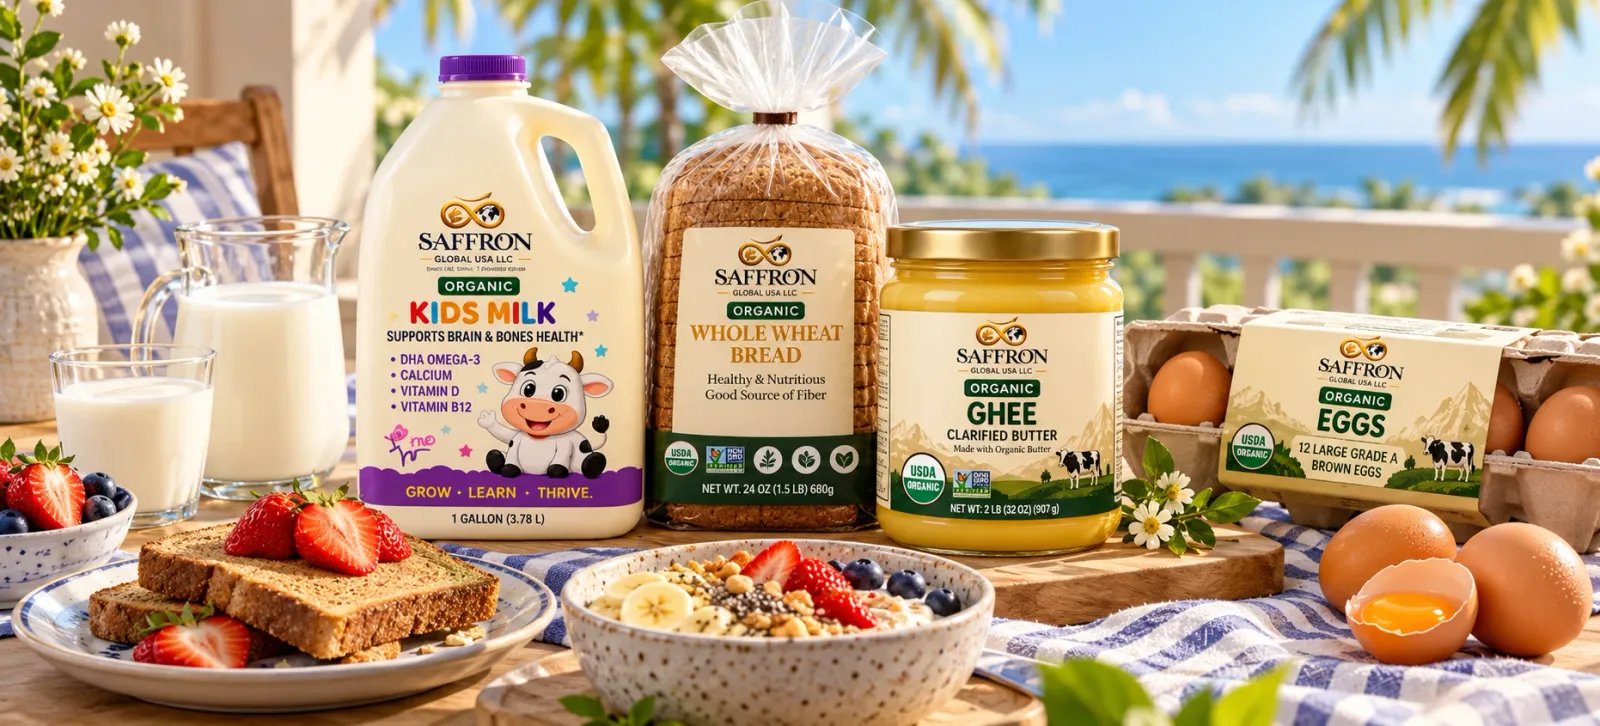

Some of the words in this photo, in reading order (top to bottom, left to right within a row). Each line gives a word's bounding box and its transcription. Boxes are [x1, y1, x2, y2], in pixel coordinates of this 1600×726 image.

[418, 233, 532, 251] SAFFRON
[715, 269, 817, 286] SAFFRON
[445, 281, 513, 292] ORGANIC
[410, 301, 479, 325] KIDS
[488, 301, 556, 325] MILK
[733, 306, 799, 316] ORGANIC
[387, 331, 445, 342] SUPPORTS
[448, 331, 482, 342] BRAIN
[485, 331, 493, 342] &
[496, 331, 533, 342] BONES
[690, 325, 767, 341] WHOLE
[771, 325, 844, 341] WHEAT
[401, 354, 424, 365] DHA
[427, 354, 481, 365] OMEGA-3
[730, 347, 802, 363] BREAD
[957, 349, 1048, 364] SAFFRON
[1319, 358, 1405, 380] SAFFRON
[401, 370, 452, 381] CALCIUM
[708, 374, 752, 387] Healthy
[755, 374, 765, 384] &
[768, 374, 826, 384] Nutritious
[1329, 376, 1356, 385] GLOBAL
[401, 386, 448, 397] VITAMIN
[451, 386, 460, 397] D
[706, 390, 737, 400] Good
[741, 390, 780, 400] Source
[783, 390, 795, 400] of
[798, 390, 827, 400] Fiber
[970, 384, 1034, 394] ORGANIC
[1326, 391, 1386, 407] ORGANIC
[401, 402, 448, 413] VITAMIN
[451, 402, 472, 413] B12
[967, 401, 1037, 426] GHEE
[1317, 408, 1386, 438] EGGS
[947, 429, 1008, 441] CLARIFIED
[1012, 429, 1058, 441] BUTTER
[1242, 434, 1266, 447] USDA
[672, 448, 692, 457] USDA
[954, 445, 974, 453] Made
[976, 445, 994, 453] with
[995, 445, 1026, 455] Organic
[1028, 445, 1051, 453] Butter
[1237, 449, 1268, 459] ORGANIC
[1299, 442, 1311, 454] 12
[1313, 444, 1348, 458] LARGE
[1351, 448, 1388, 463] GRADE
[1390, 452, 1398, 464] A
[911, 465, 936, 478] USDA
[1312, 460, 1351, 475] BROWN
[1354, 465, 1382, 478] EGGS
[702, 484, 721, 494] NET
[724, 484, 741, 494] WT.
[743, 484, 755, 494] 24
[758, 484, 771, 494] OZ
[773, 484, 790, 495] (1.5
[792, 484, 808, 495] LB)
[810, 484, 834, 496] 680g
[908, 481, 940, 492] ORGANIC
[406, 487, 451, 499] GROW
[469, 487, 516, 499] LEARN
[538, 487, 593, 499] THRIVE.
[950, 504, 966, 514] NET
[967, 504, 982, 514] WT:
[984, 504, 990, 514] 2
[991, 504, 1001, 514] LB
[1004, 504, 1016, 515] (32
[1018, 504, 1032, 515] OZ)
[1034, 504, 1051, 515] (907
[1052, 504, 1060, 515] g)
[452, 514, 457, 524] 1
[461, 514, 503, 524] GALLON
[506, 514, 533, 525] (3.78
[536, 514, 545, 525] L)
